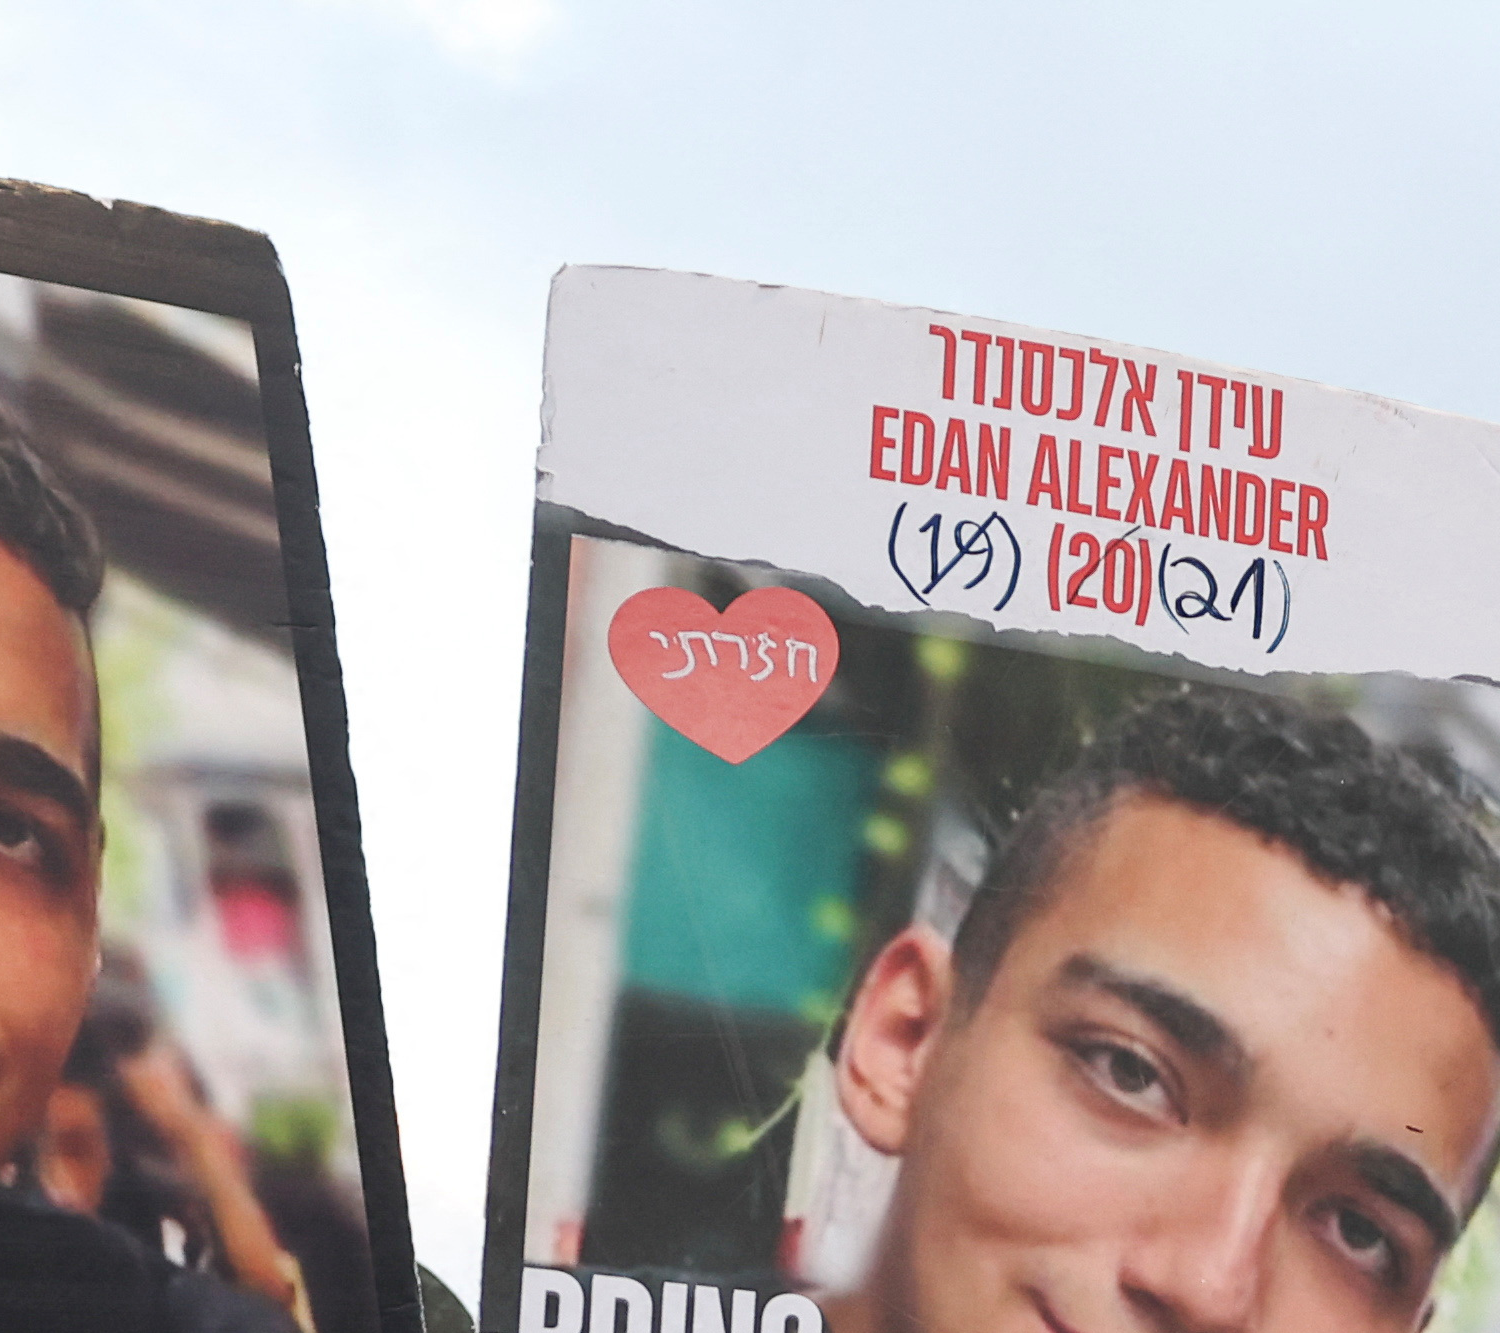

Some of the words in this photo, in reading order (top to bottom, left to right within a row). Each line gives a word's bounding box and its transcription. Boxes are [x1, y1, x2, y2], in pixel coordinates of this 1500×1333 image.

[929, 324, 1158, 437] אלכסנדר
[1175, 367, 1285, 462] עידן
[869, 405, 1012, 501] EDAN
[1027, 433, 1330, 561] ALEXANDER
[649, 629, 821, 684] חזרתי
